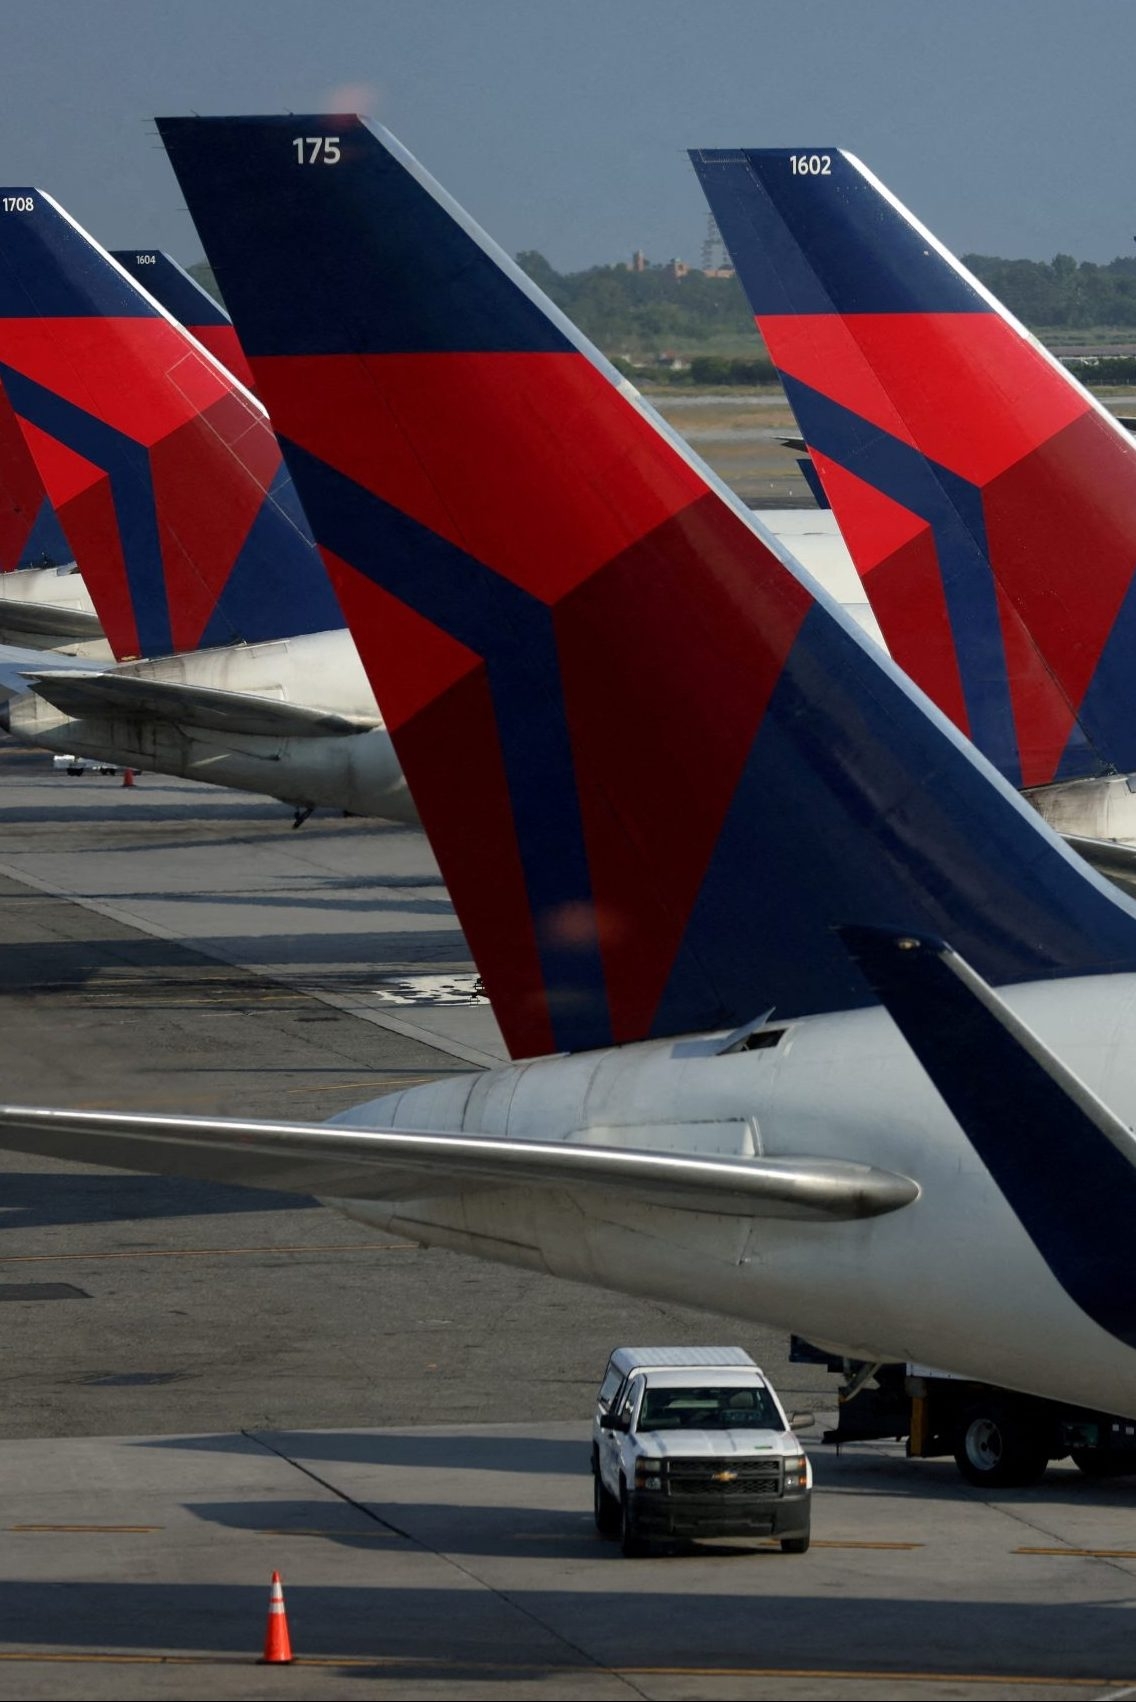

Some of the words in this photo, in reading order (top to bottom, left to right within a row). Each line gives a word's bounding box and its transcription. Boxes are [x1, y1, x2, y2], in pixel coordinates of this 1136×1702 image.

[291, 136, 341, 165] 175
[789, 155, 832, 175] 1602
[2, 196, 35, 212] 1708
[136, 255, 157, 265] 1604
